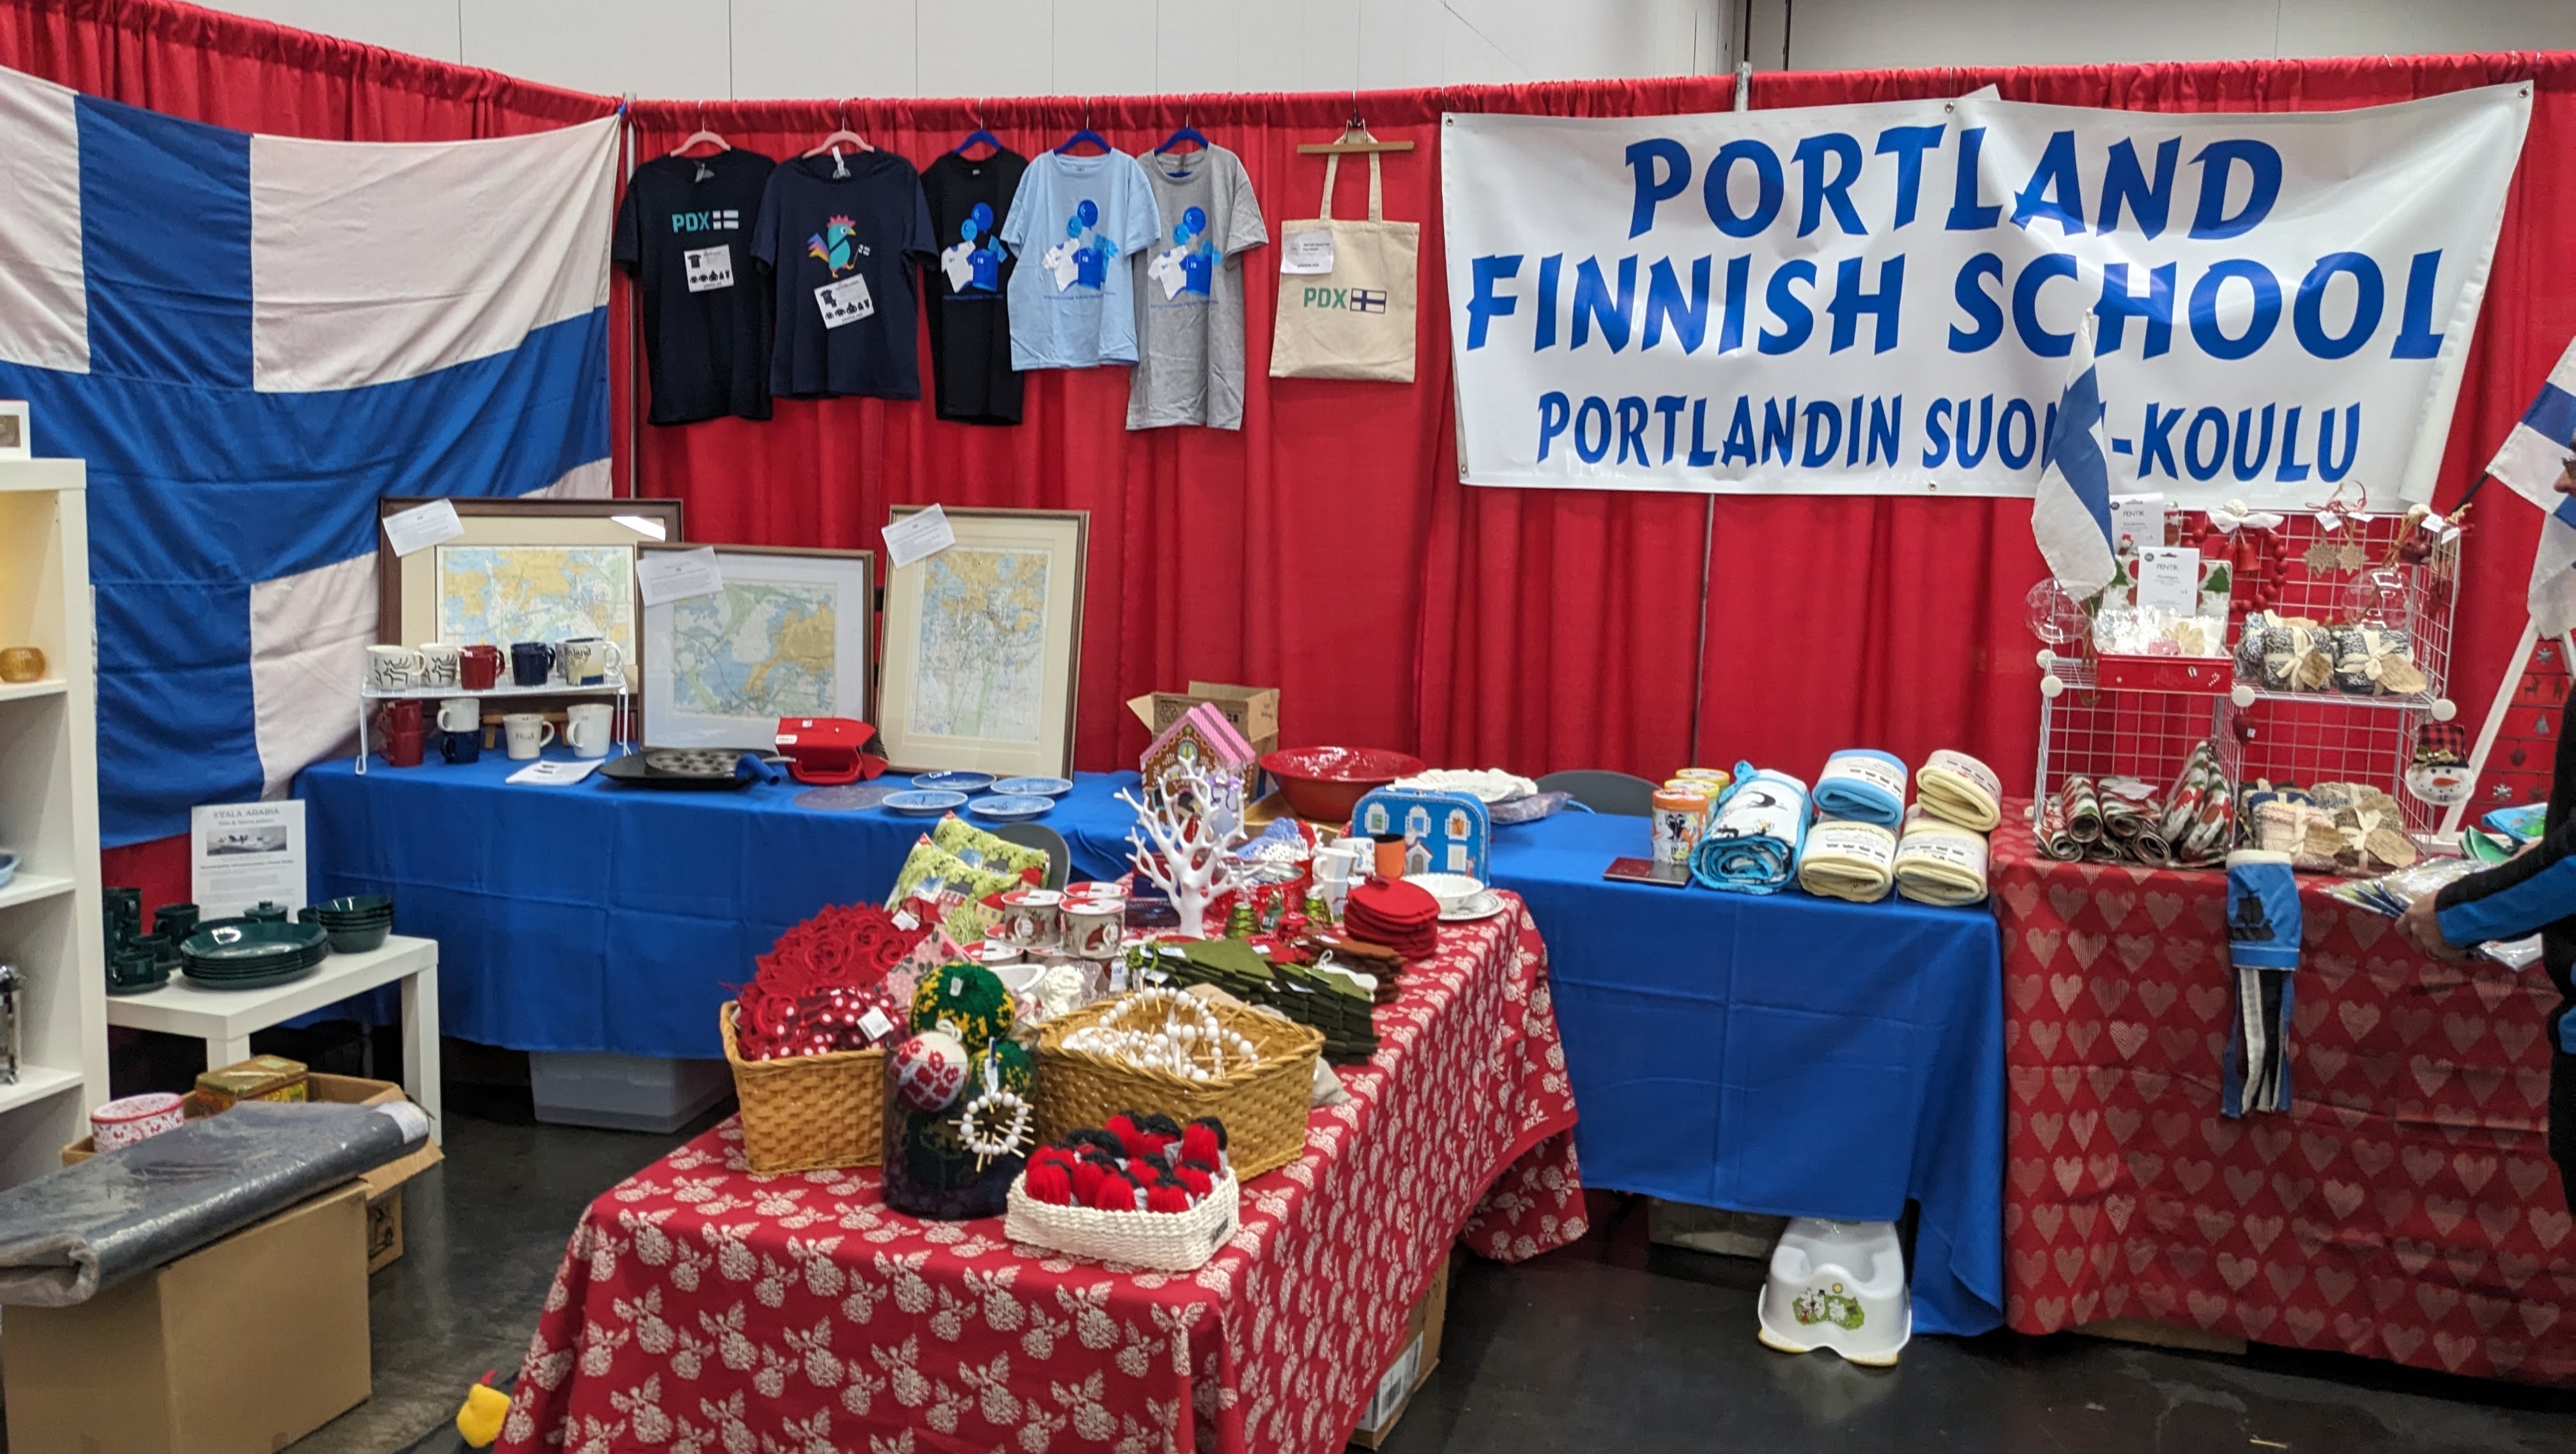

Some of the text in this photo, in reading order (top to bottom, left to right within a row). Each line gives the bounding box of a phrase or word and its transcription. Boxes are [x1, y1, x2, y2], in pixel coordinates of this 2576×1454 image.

[671, 211, 710, 233] PDX
[1626, 123, 2283, 241] PORTLAND
[1303, 287, 1347, 310] PDX
[1466, 249, 2444, 362] FINNISH SCHOOL
[1537, 390, 2361, 484] PORTLANDIN SUO-KOULU
